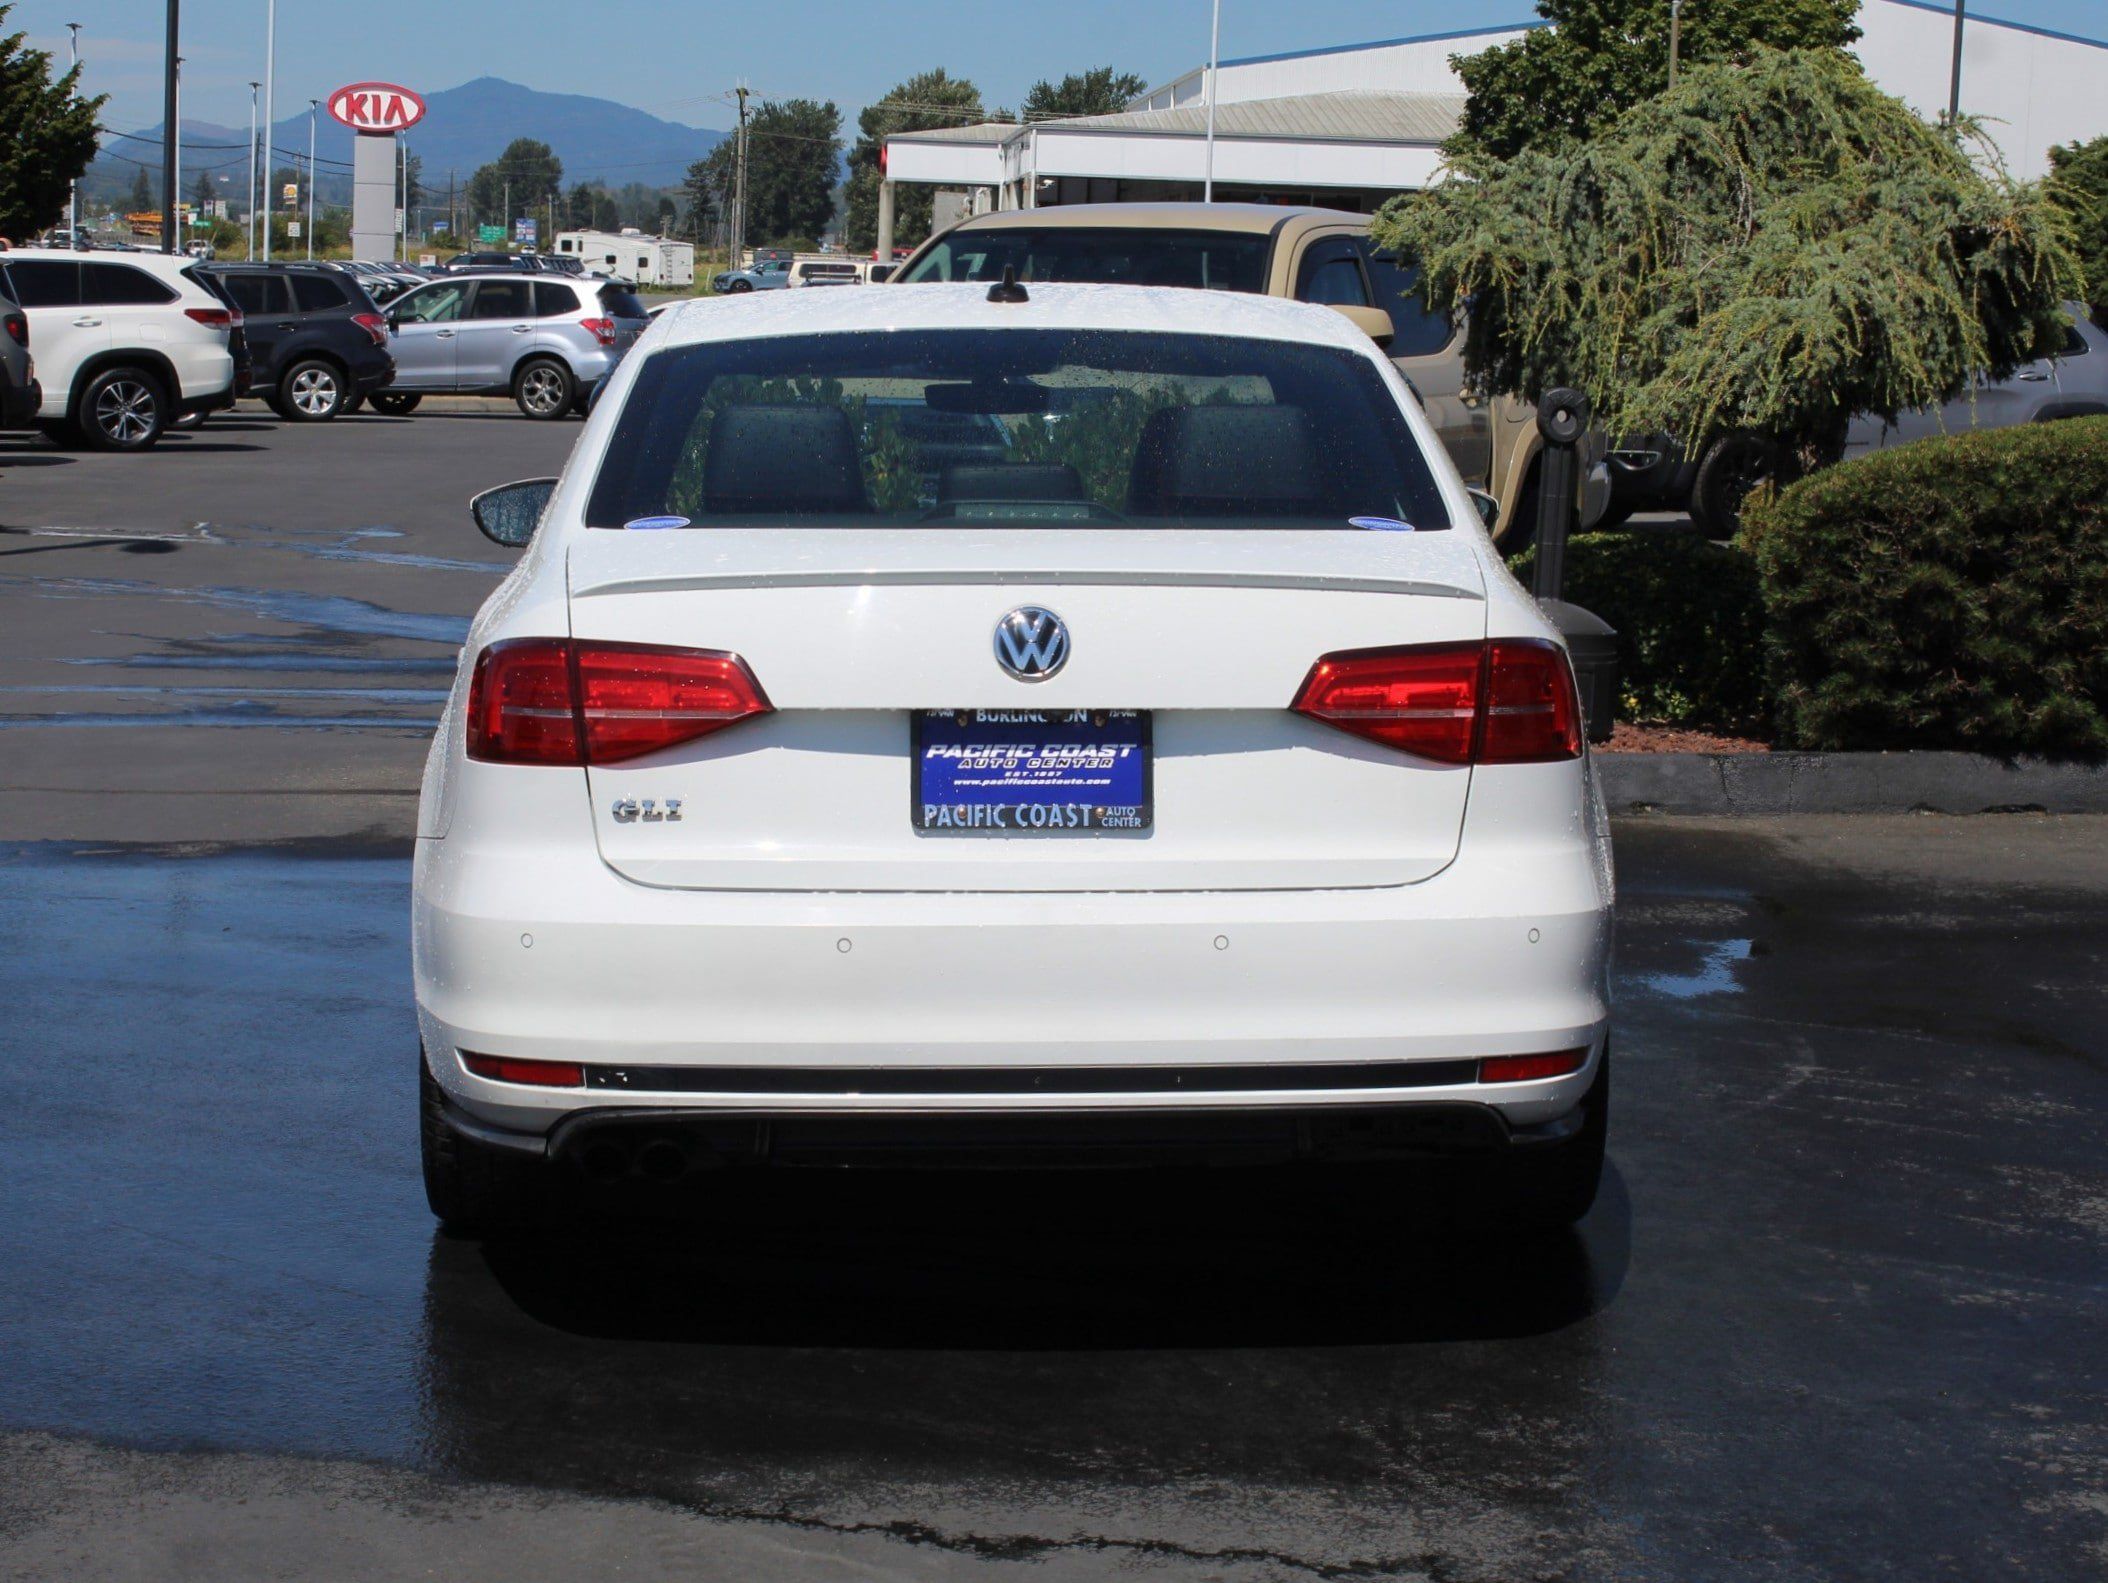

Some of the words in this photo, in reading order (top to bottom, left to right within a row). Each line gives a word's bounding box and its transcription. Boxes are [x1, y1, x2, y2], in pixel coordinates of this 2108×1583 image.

[345, 94, 408, 124] KIA
[998, 609, 1063, 671] VW
[926, 744, 1036, 758] PACIFIC
[1040, 744, 1137, 758] COAST
[957, 758, 1018, 769] AUTO
[1026, 758, 1114, 769] CENTER
[612, 800, 682, 823] GLI
[924, 803, 1006, 827] PACIFIC
[1015, 803, 1092, 827] COAST
[1106, 807, 1136, 817] AUTO
[1101, 817, 1141, 827] CENTER
